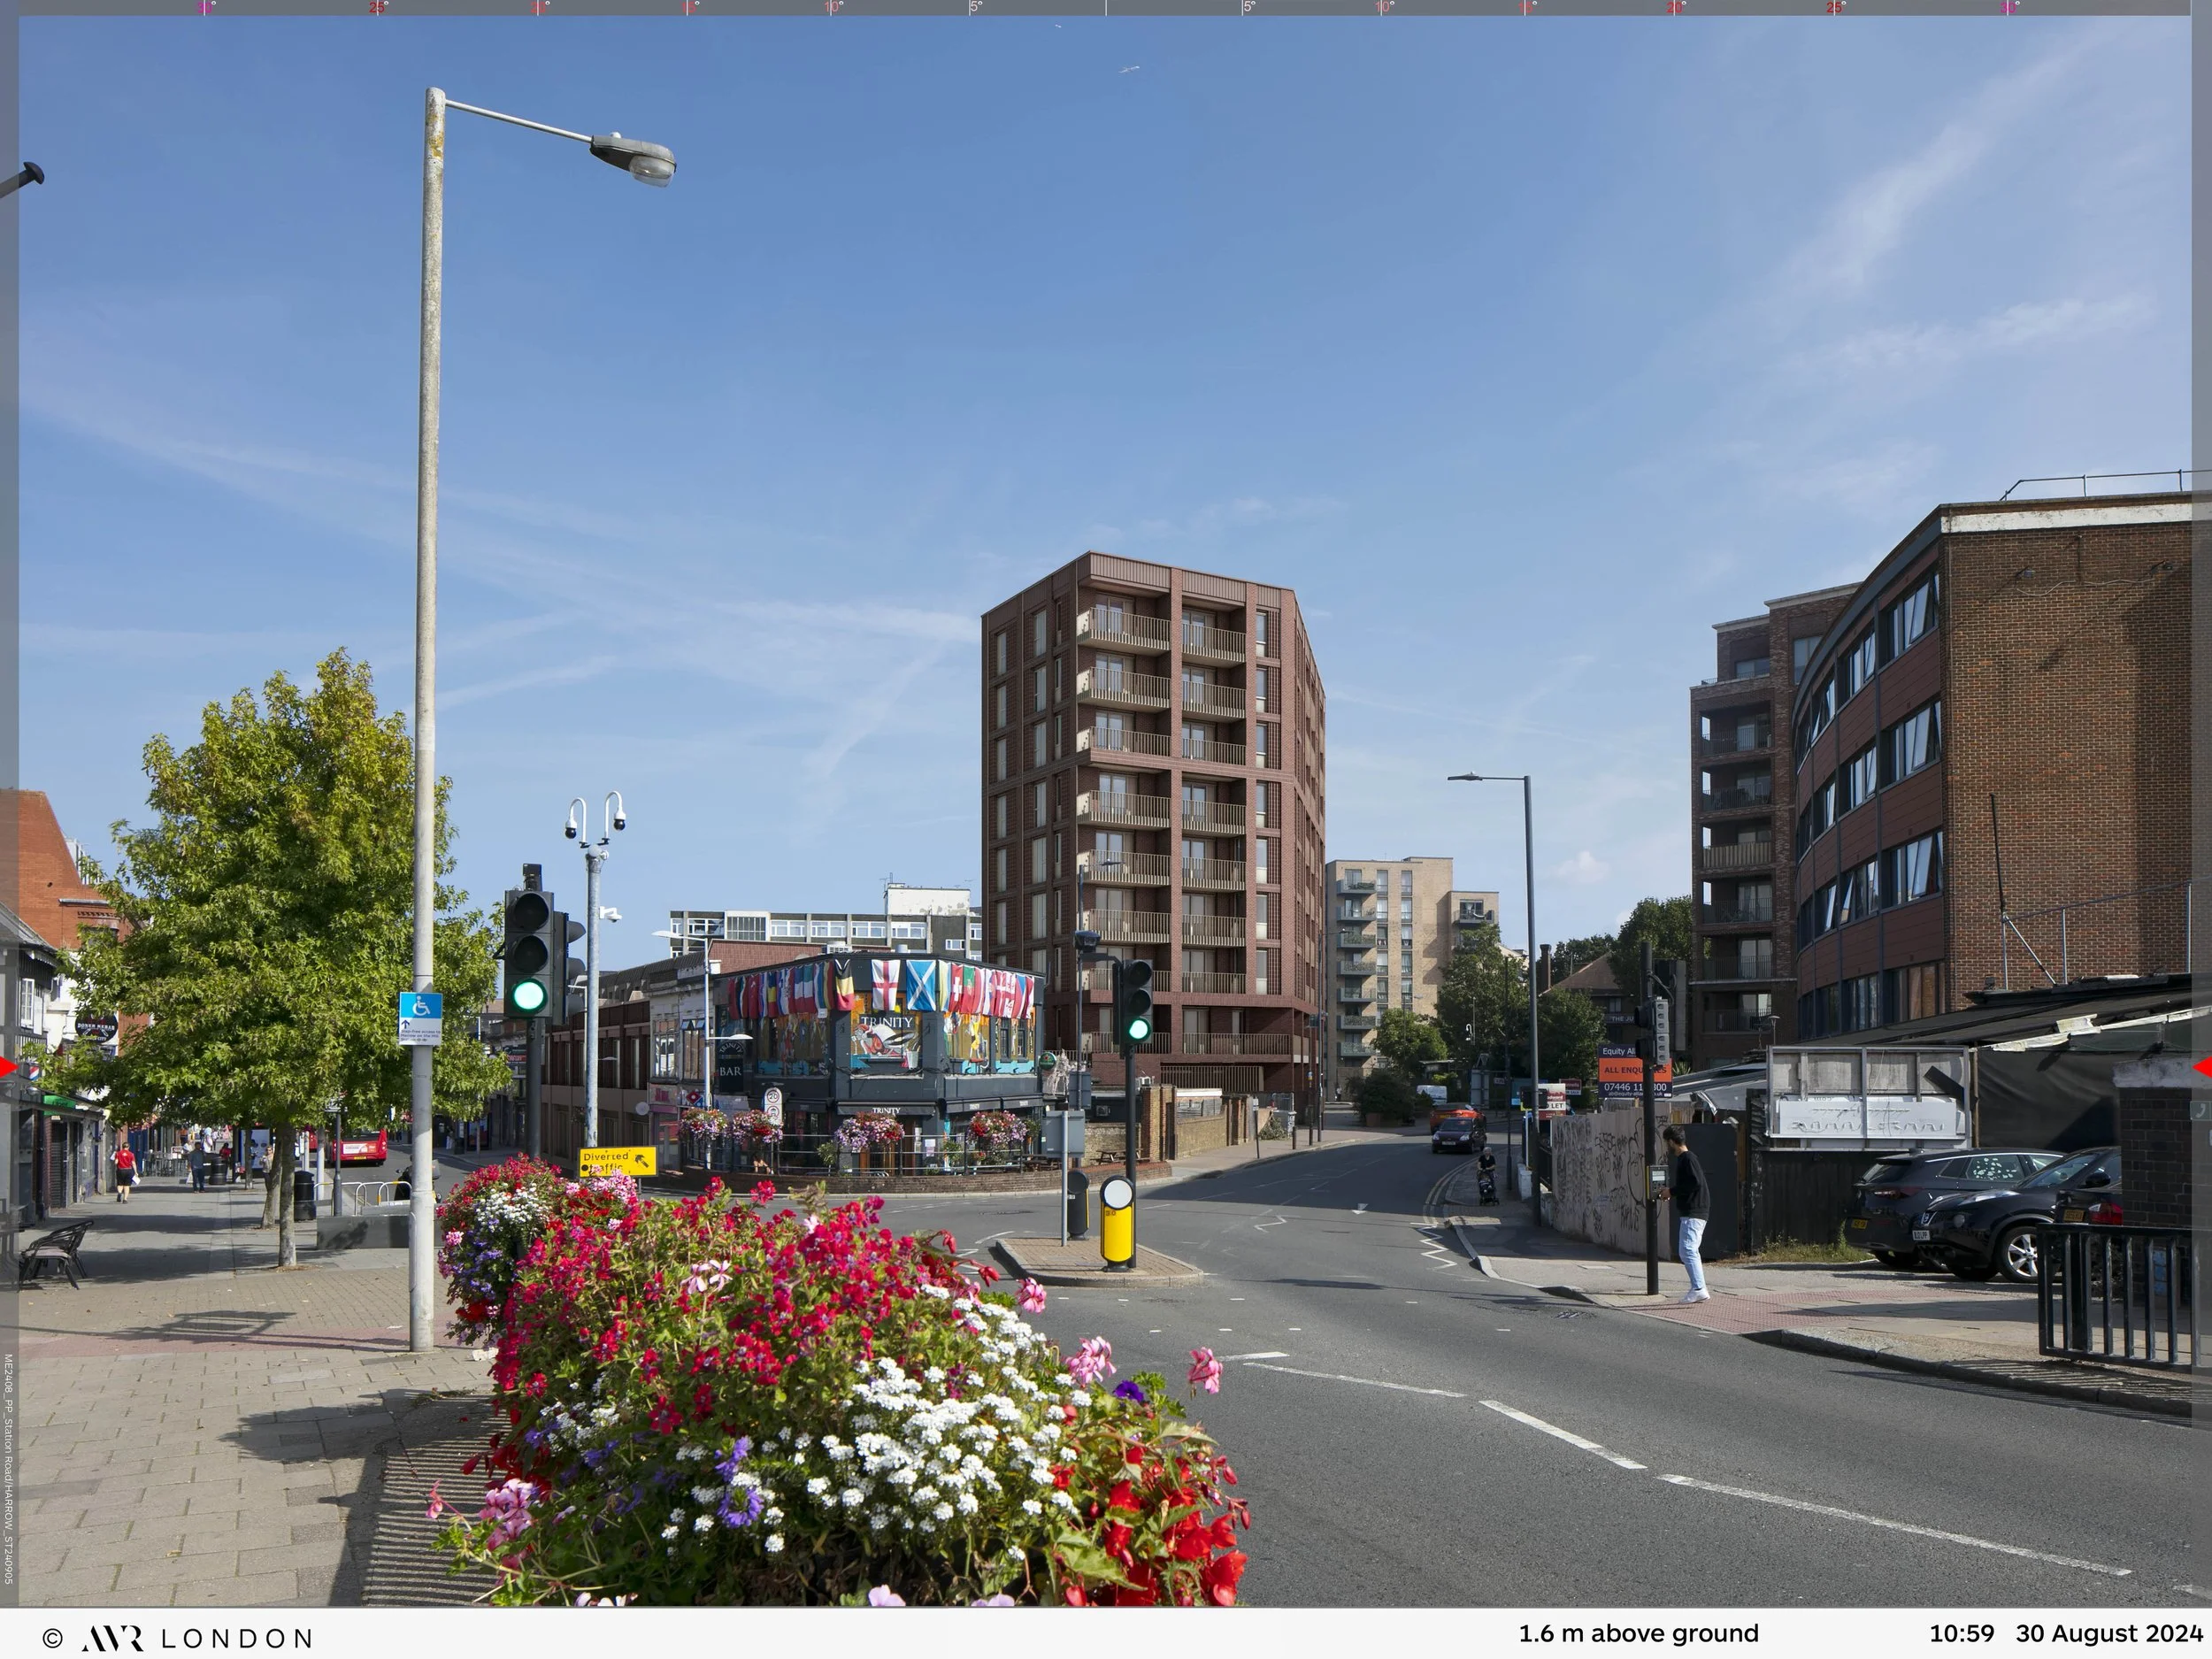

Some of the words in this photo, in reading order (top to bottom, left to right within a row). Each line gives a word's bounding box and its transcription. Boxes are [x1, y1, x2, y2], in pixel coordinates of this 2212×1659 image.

[861, 1017, 913, 1027] TRINITY
[719, 1042, 743, 1053] TRINITY
[719, 1066, 741, 1076] BAR
[583, 1152, 629, 1161] Diverted
[589, 1163, 624, 1171] taffic
